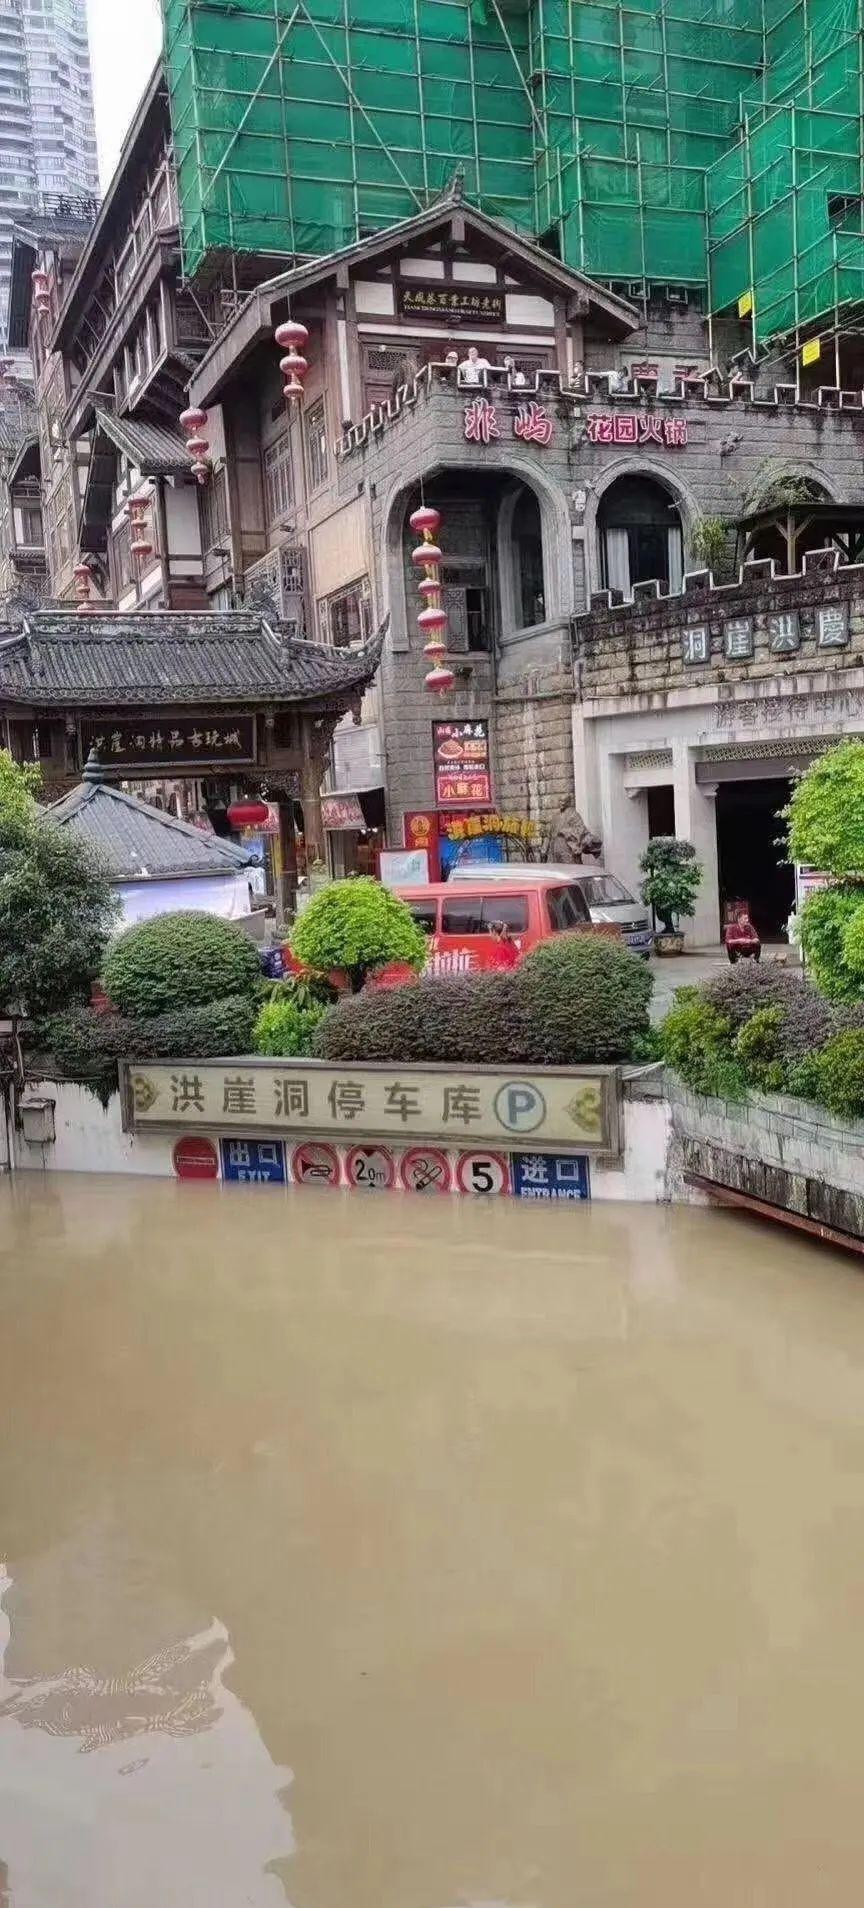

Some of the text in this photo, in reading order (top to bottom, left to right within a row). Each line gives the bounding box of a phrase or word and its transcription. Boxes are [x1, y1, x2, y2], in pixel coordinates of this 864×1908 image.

[588, 412, 688, 445] 花园火锅
[170, 1073, 483, 1126] 洪崖洞停车库
[507, 1089, 538, 1125] P
[229, 1141, 281, 1168] 出口
[238, 1170, 271, 1184] EXIT
[472, 1161, 494, 1193] 5
[520, 1186, 582, 1199] ENTRANCE
